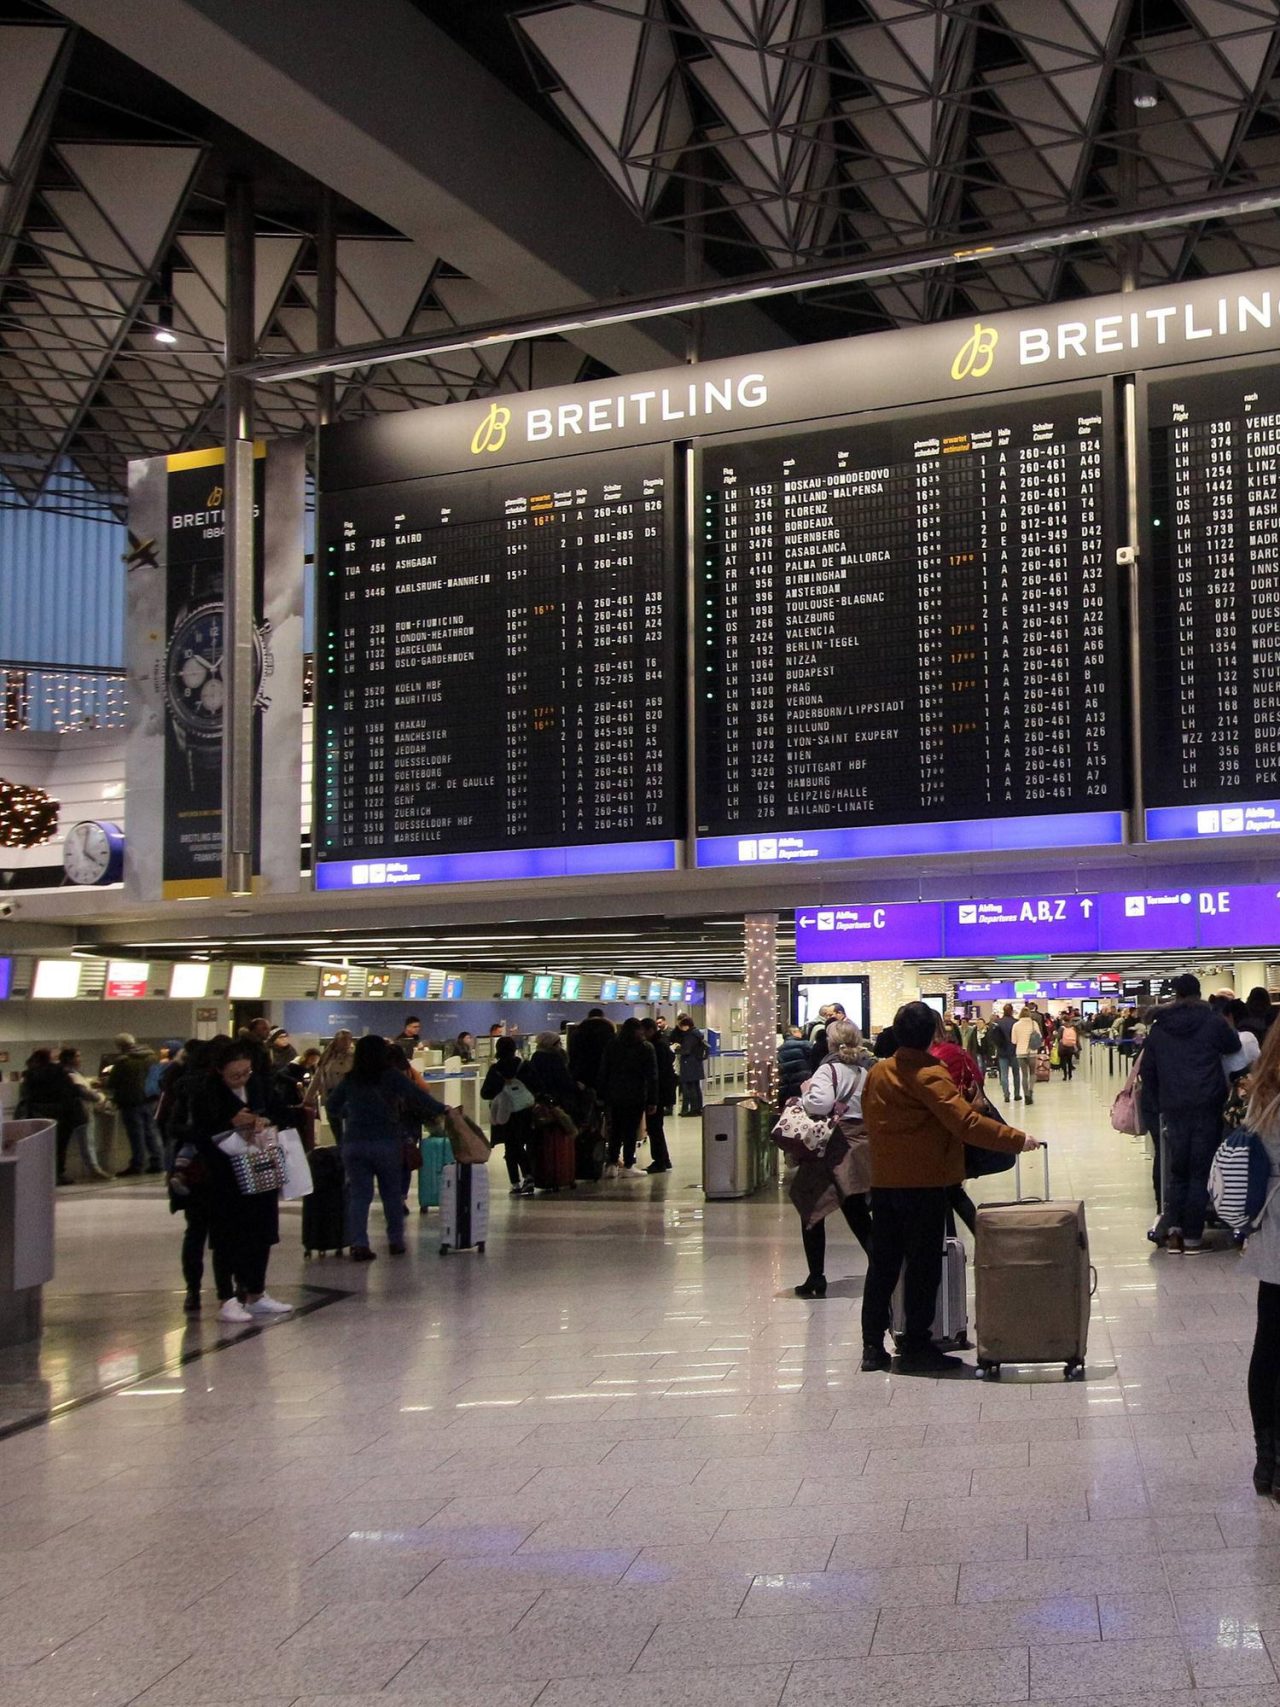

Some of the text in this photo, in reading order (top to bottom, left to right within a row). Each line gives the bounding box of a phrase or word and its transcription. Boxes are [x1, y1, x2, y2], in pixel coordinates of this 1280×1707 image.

[527, 373, 767, 442] BREITLING
[1248, 459, 1276, 473] LINZ
[1248, 488, 1277, 502] GRAZ
[785, 504, 827, 518] FLORENZ
[785, 516, 834, 532] BORDEAUX
[785, 529, 840, 545] NUERNBERG
[785, 542, 846, 558] CASABLANCA
[785, 550, 890, 571] PALMA DE MALLORCA
[785, 569, 846, 585] BIRMINGHAM
[785, 584, 840, 598] AMSTERDAM
[786, 611, 835, 625] SALZBURG
[786, 625, 835, 639] VALENCIA
[786, 654, 816, 666] NIZZA
[786, 666, 834, 680] BUDAPEST
[786, 682, 810, 693] PRAG
[786, 695, 823, 706] VERONA
[787, 721, 829, 734] BILLUND
[1200, 891, 1230, 915] D,E
[1020, 899, 1066, 923] A,B,Z
[836, 920, 871, 931] Departures
[873, 908, 886, 929] C
[978, 913, 1017, 924] Departures
